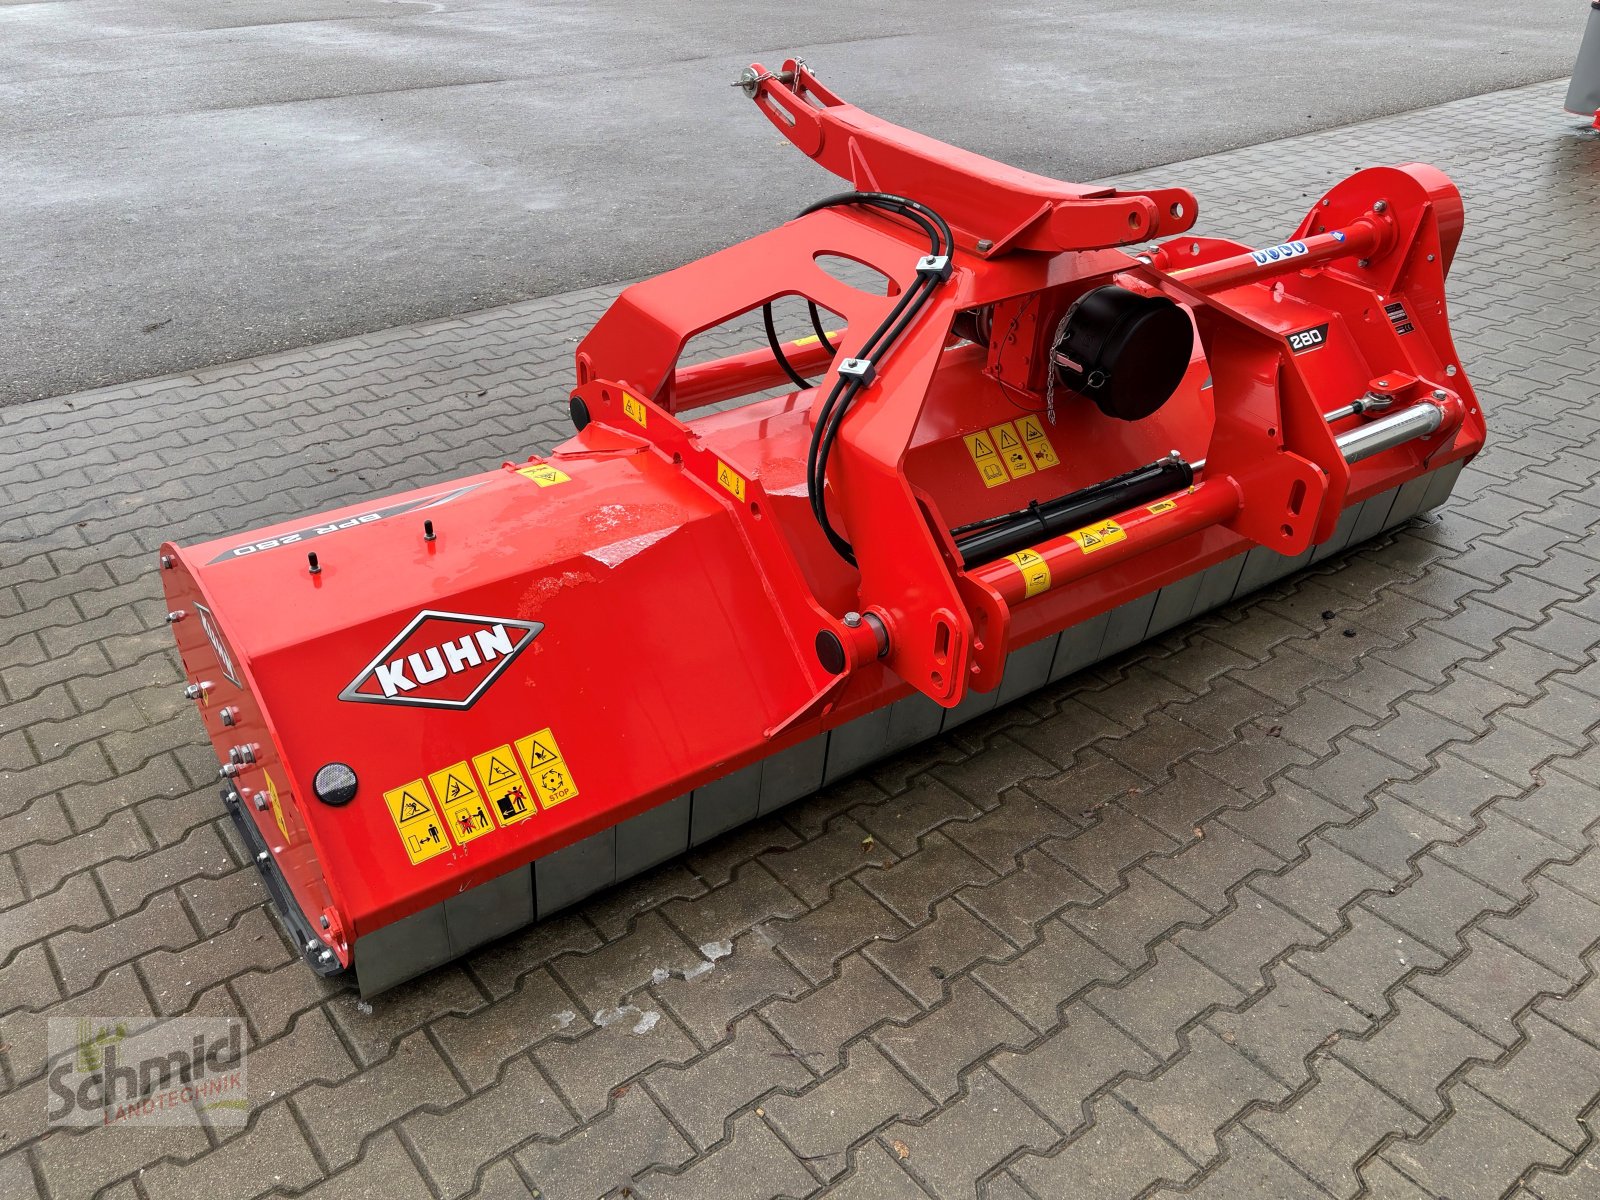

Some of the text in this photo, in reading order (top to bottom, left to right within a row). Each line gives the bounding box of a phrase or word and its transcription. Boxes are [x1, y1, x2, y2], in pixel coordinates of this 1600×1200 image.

[1290, 329, 1322, 349] 280
[233, 513, 382, 556] BPR 280
[374, 623, 514, 698] KUHN
[549, 788, 569, 802] STOP
